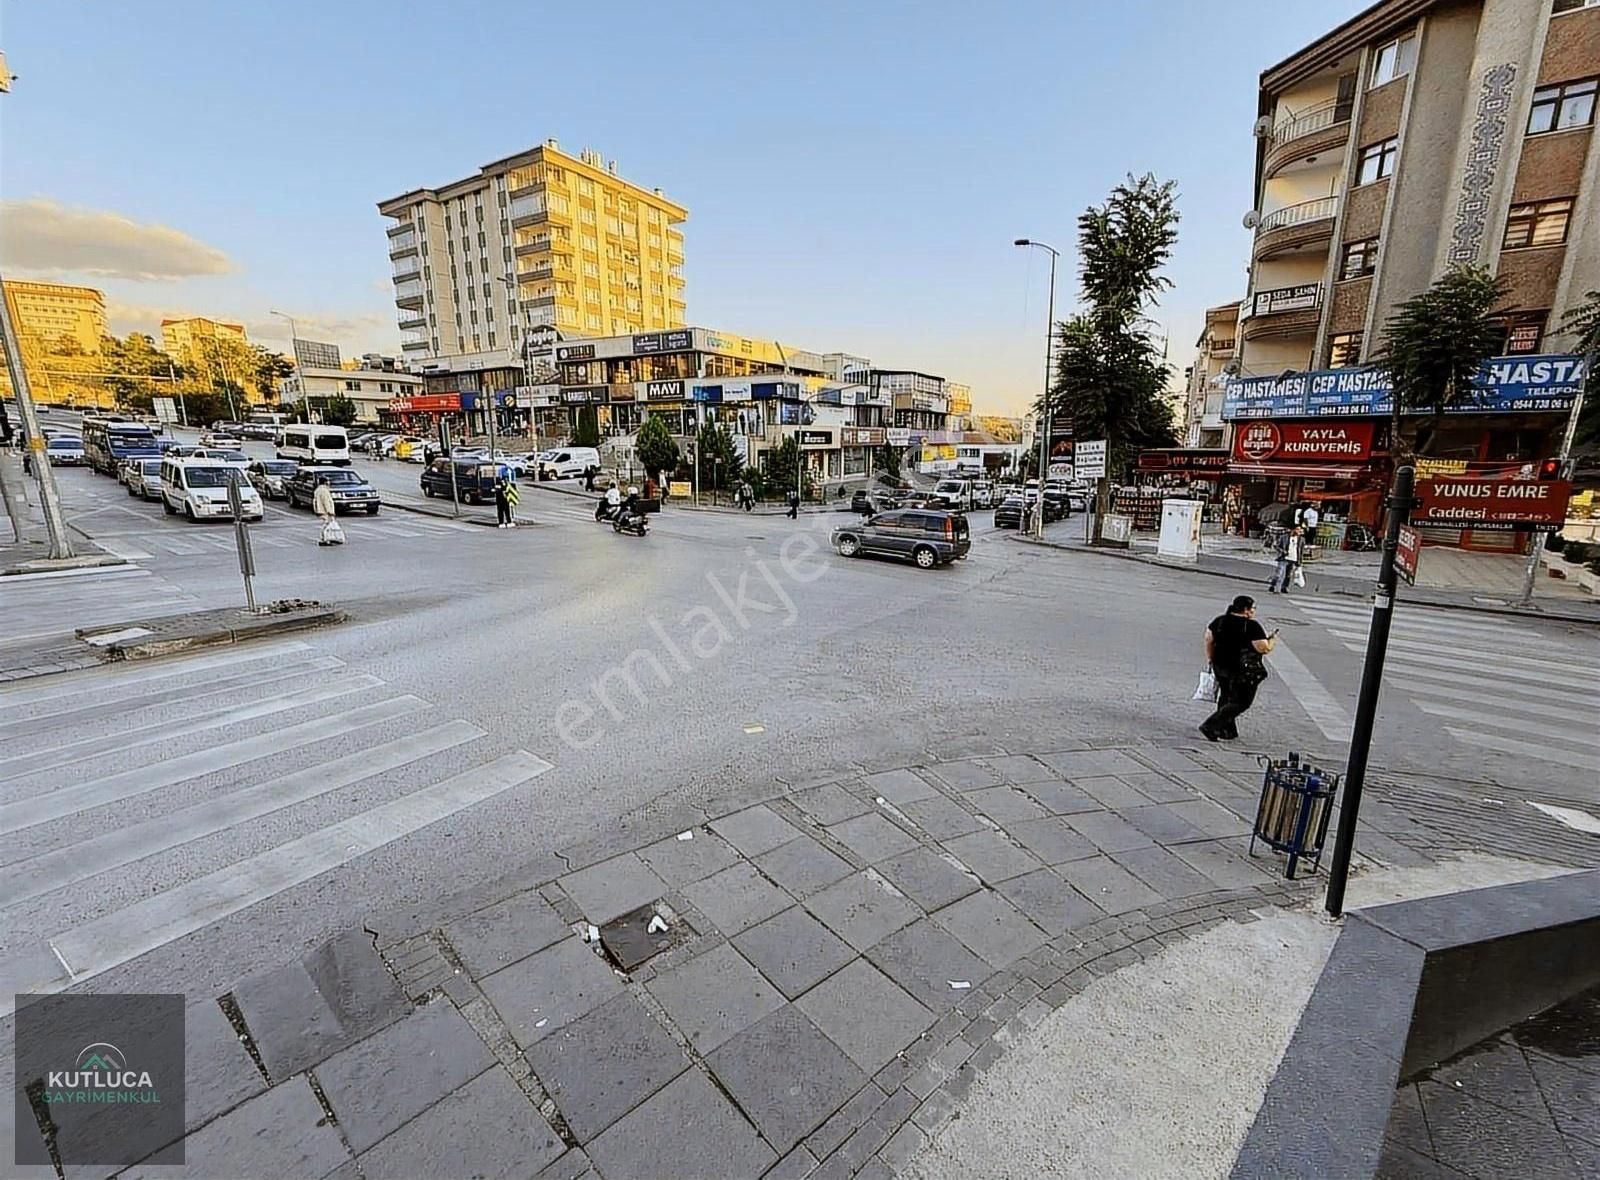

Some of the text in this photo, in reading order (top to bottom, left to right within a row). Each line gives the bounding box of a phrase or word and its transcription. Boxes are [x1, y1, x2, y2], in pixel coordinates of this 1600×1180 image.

[649, 382, 680, 396] MAVI
[1226, 378, 1305, 400] CEP HASTANESİ
[1312, 377, 1336, 394] CEP
[1302, 429, 1346, 440] YAYLA
[1284, 440, 1362, 455] KURUYEMİŞ
[1433, 484, 1549, 499] YUNUS EMRE
[1428, 506, 1487, 520] Caddesi
